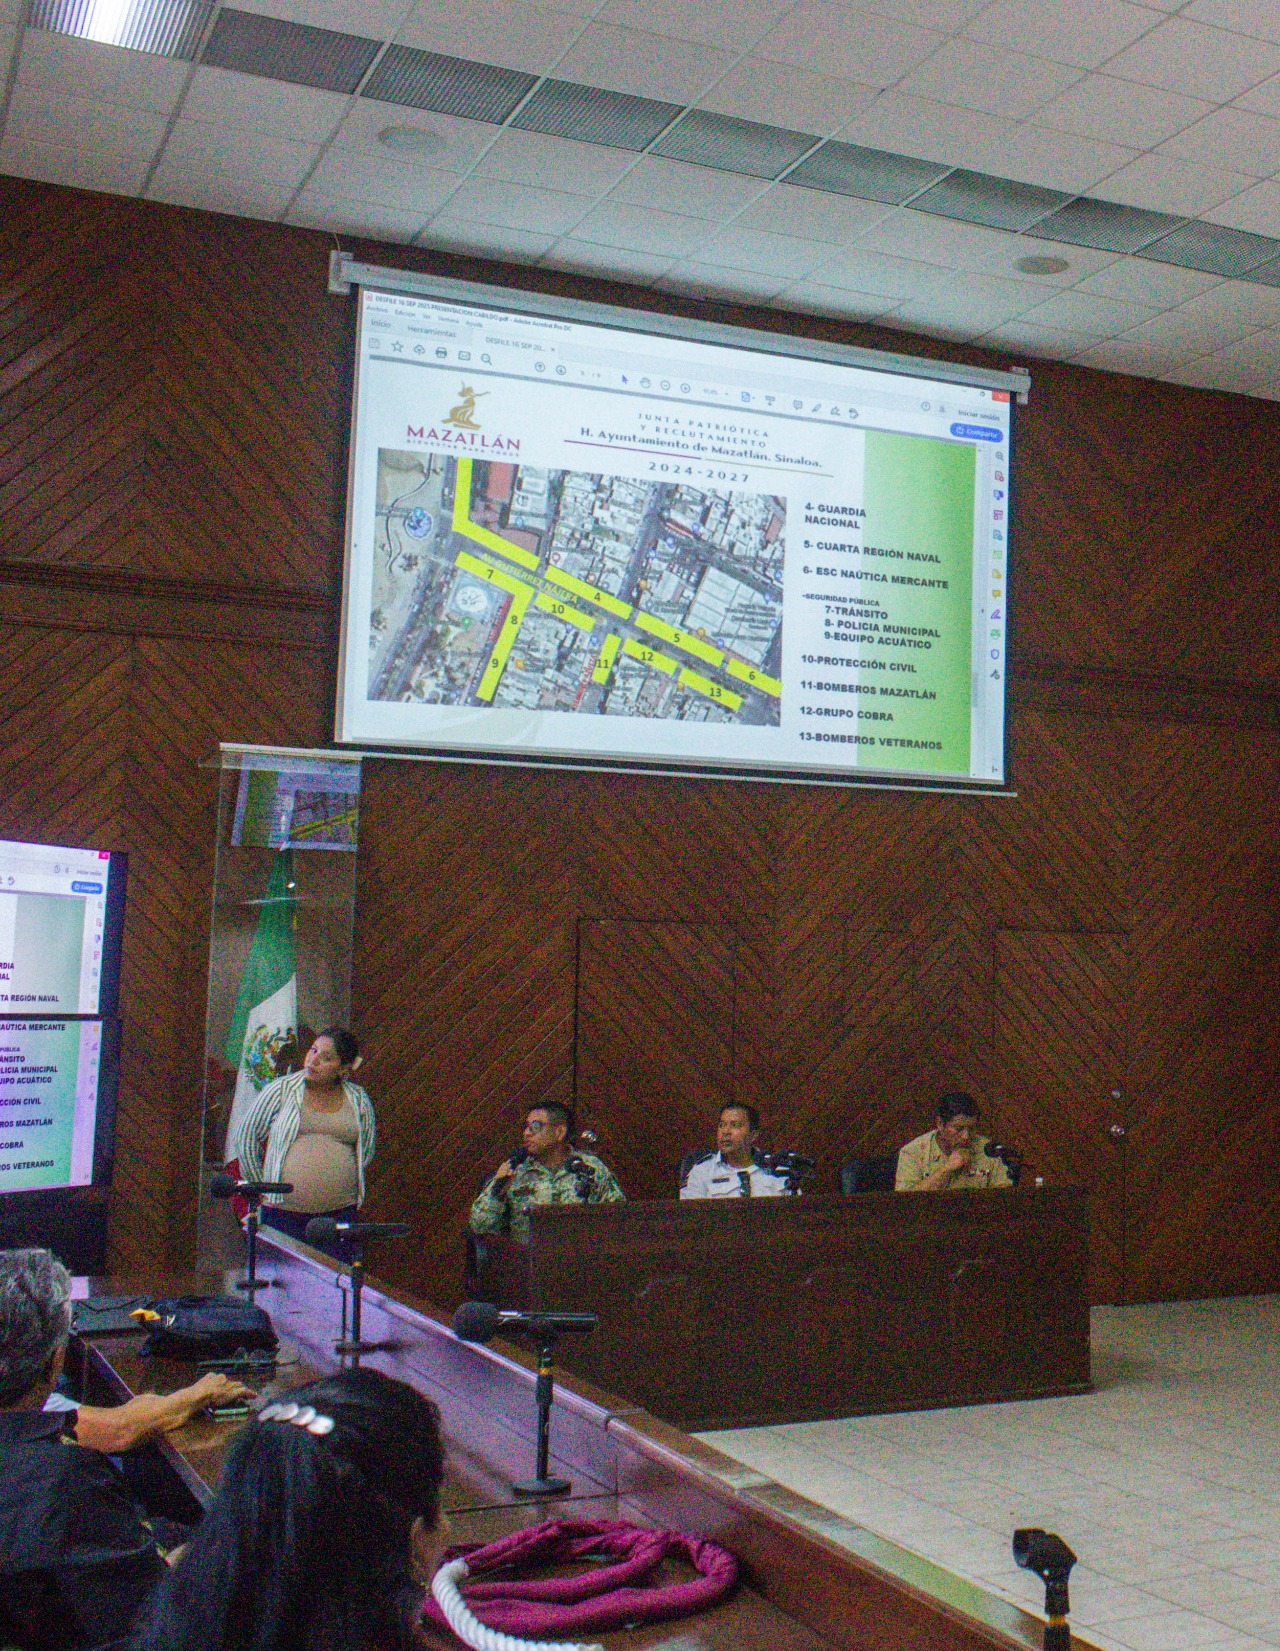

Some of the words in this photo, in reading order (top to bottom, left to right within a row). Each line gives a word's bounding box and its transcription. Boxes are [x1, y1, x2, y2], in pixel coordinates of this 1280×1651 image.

[371, 319, 391, 328] Inicio
[407, 325, 457, 338] Herramientas
[486, 336, 510, 347] DESFILE
[521, 342, 532, 350] SEP
[958, 409, 978, 417] Iniciar
[638, 412, 680, 424] JUNTA
[688, 418, 769, 438] PATRIÓTICA
[407, 424, 520, 451] MAZATLÁN
[580, 427, 594, 438] H.
[598, 430, 690, 452] Ayuntamiento
[692, 442, 708, 452] de
[655, 425, 767, 448] RECLUTAMIENTO
[648, 461, 750, 483] 2024-2027
[805, 502, 815, 511] 4-
[817, 504, 867, 518] GUARDIA
[804, 514, 861, 529] NACIONAL
[803, 540, 814, 549] 5-
[817, 541, 860, 554] CUARTA
[863, 546, 904, 559] REGIÓN
[907, 552, 942, 564] NAVAL
[487, 569, 494, 579] 7
[802, 566, 813, 575] 6-
[816, 567, 838, 577] ESC
[840, 568, 888, 583] NAÚTICA
[891, 576, 949, 589] MERCANTE
[594, 592, 601, 602] 4
[552, 604, 565, 614] 10
[825, 605, 889, 620] 7-TRÁNSITO
[510, 615, 518, 625] 8
[824, 619, 835, 628] 8-
[883, 625, 941, 638] MUNICIPAL
[674, 633, 680, 643] 5
[824, 631, 875, 644] 9-EQUIPO
[877, 635, 932, 649] ACUÁTICO
[491, 658, 499, 668] 9
[597, 659, 609, 668] 11
[641, 651, 654, 661] 12
[801, 654, 887, 671] 10-PROTECCIÓN
[889, 662, 917, 673] CIVIL
[748, 671, 756, 681] 6
[709, 687, 722, 697] 13
[800, 680, 877, 695] 11-BOMBEROS
[879, 686, 937, 700] MAZATLÁN
[799, 706, 854, 718] 12-GRUPO
[857, 710, 894, 722] COBRA
[799, 732, 876, 746] 13-BOMBEROS
[879, 737, 942, 750] VETERANOS
[28, 1023, 66, 1031] MERCANTE
[20, 1065, 58, 1073] MUNICIPAL
[15, 1118, 53, 1127] MAZATLÁN
[13, 1160, 55, 1170] VETERANOS
